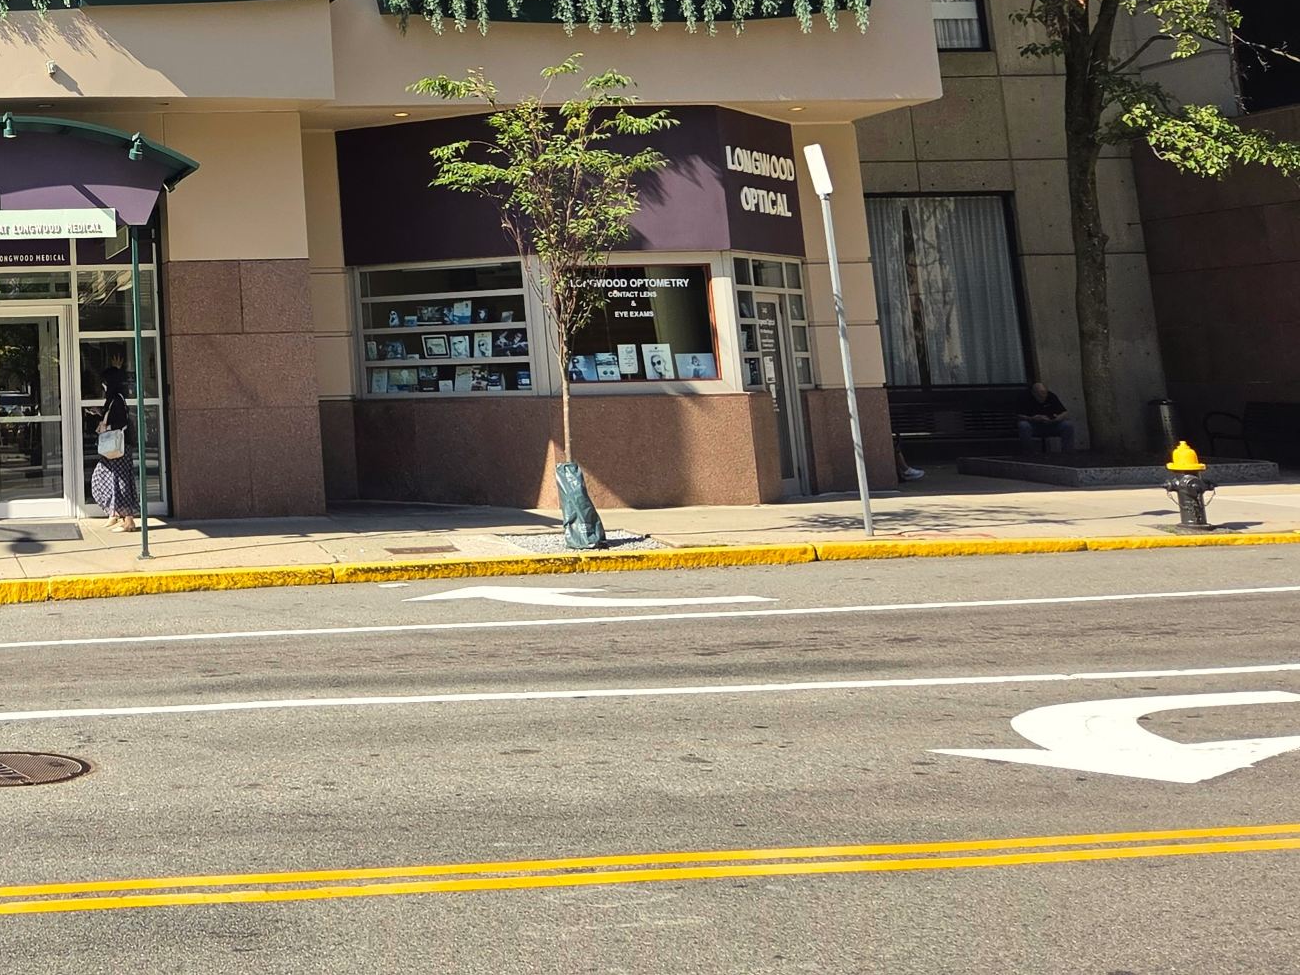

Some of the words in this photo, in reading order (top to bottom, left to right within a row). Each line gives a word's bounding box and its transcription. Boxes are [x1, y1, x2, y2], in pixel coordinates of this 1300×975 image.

[725, 145, 795, 181] LONGWOOD
[740, 186, 792, 217] OPTICAL
[13, 224, 62, 235] LONGWOOD
[68, 223, 102, 234] MEDICAL
[36, 254, 66, 262] MEDICAL
[629, 278, 690, 288] OPTOMETRY
